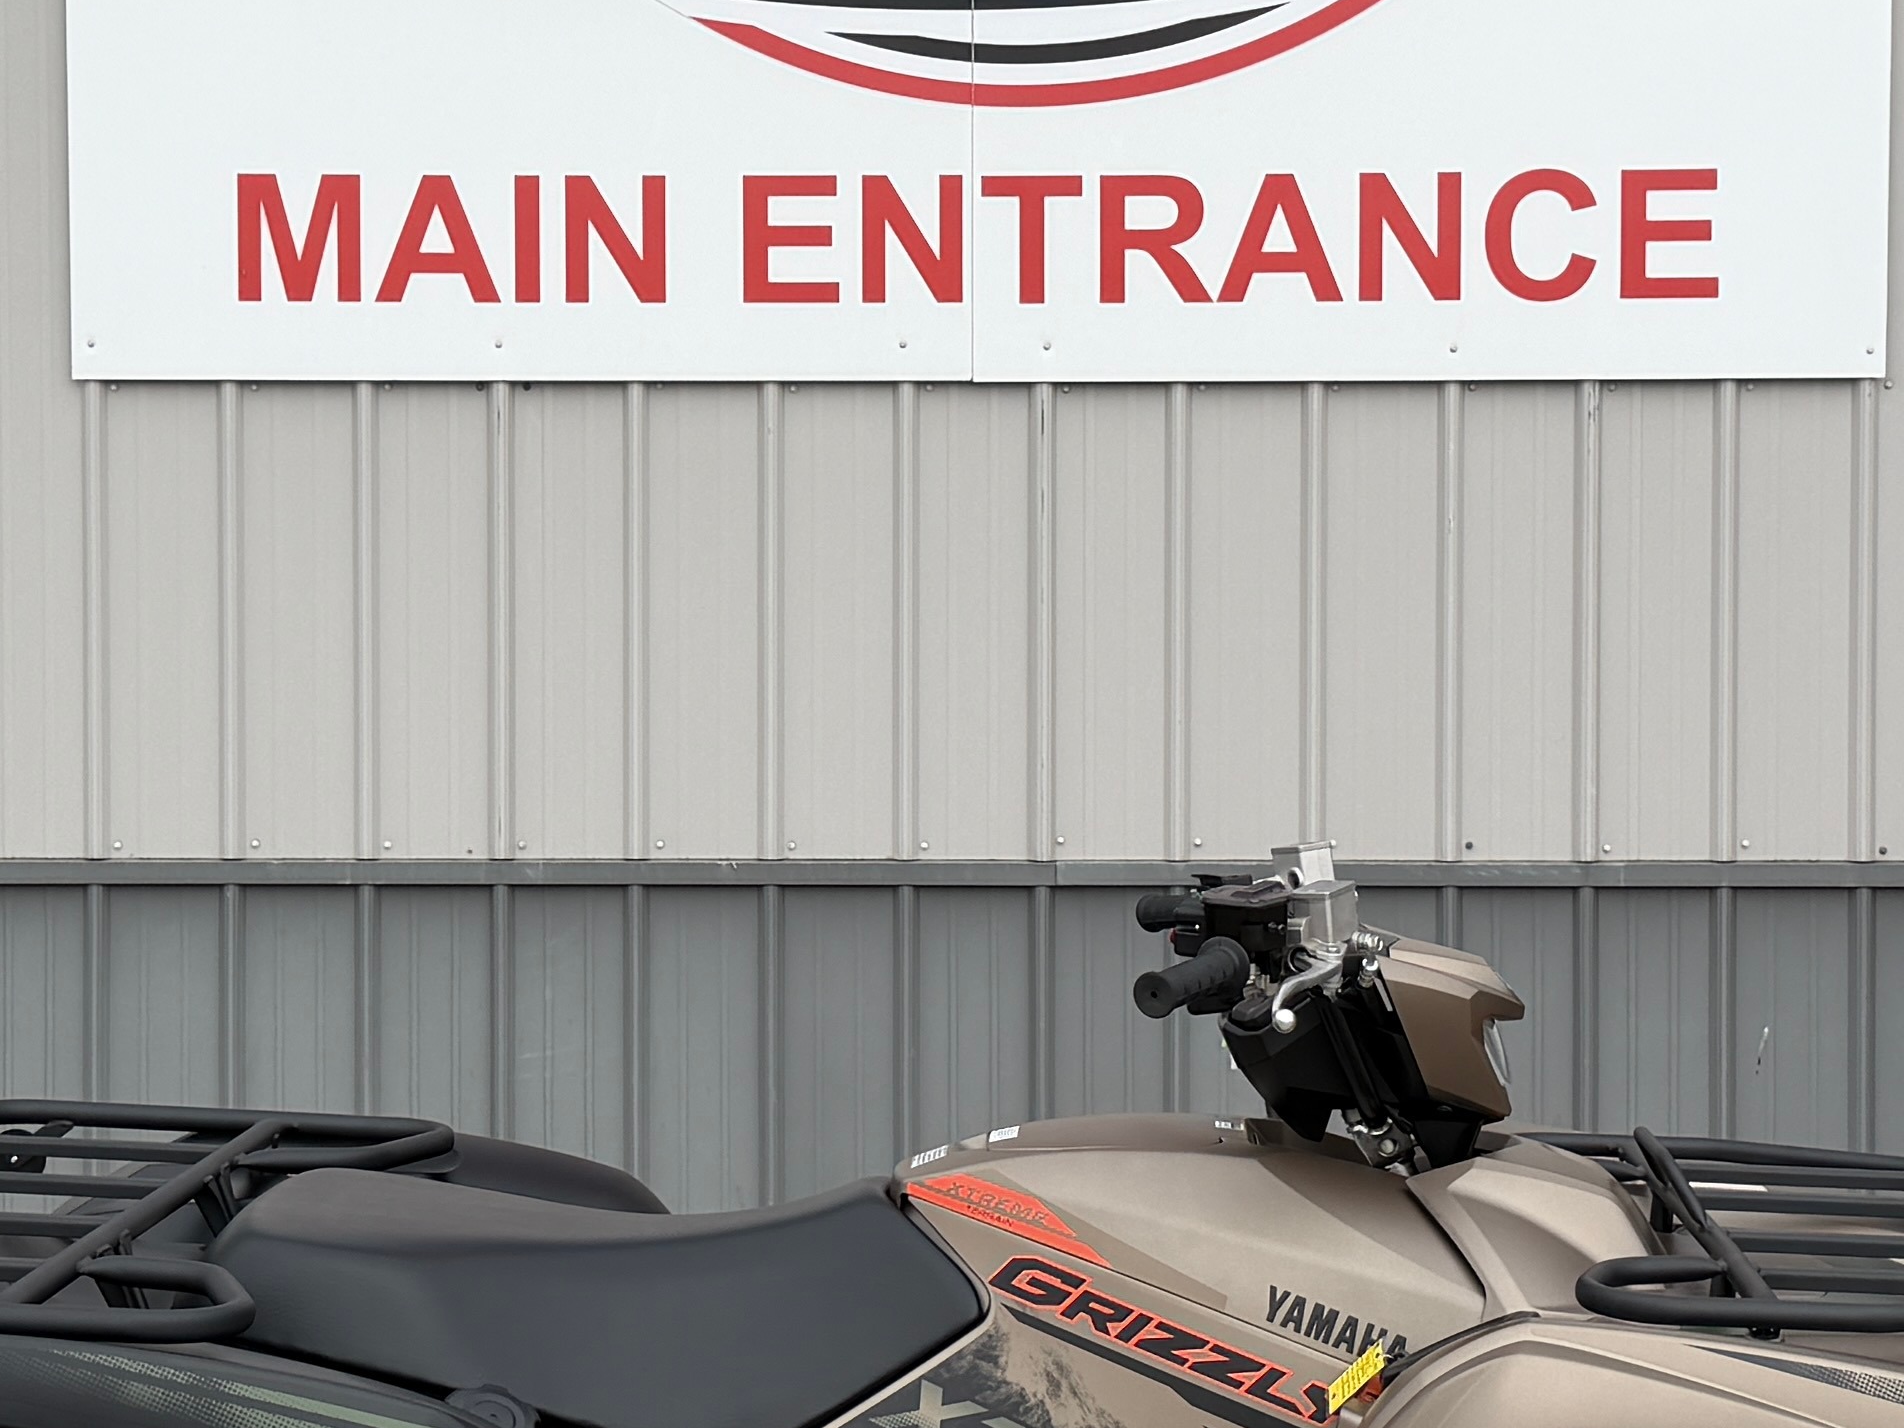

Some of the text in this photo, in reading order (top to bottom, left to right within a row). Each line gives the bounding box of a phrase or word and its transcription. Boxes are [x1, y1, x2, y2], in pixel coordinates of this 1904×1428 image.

[236, 169, 1720, 303] MAIN ENTRANCE
[1266, 1285, 1408, 1357] YAMAHA
